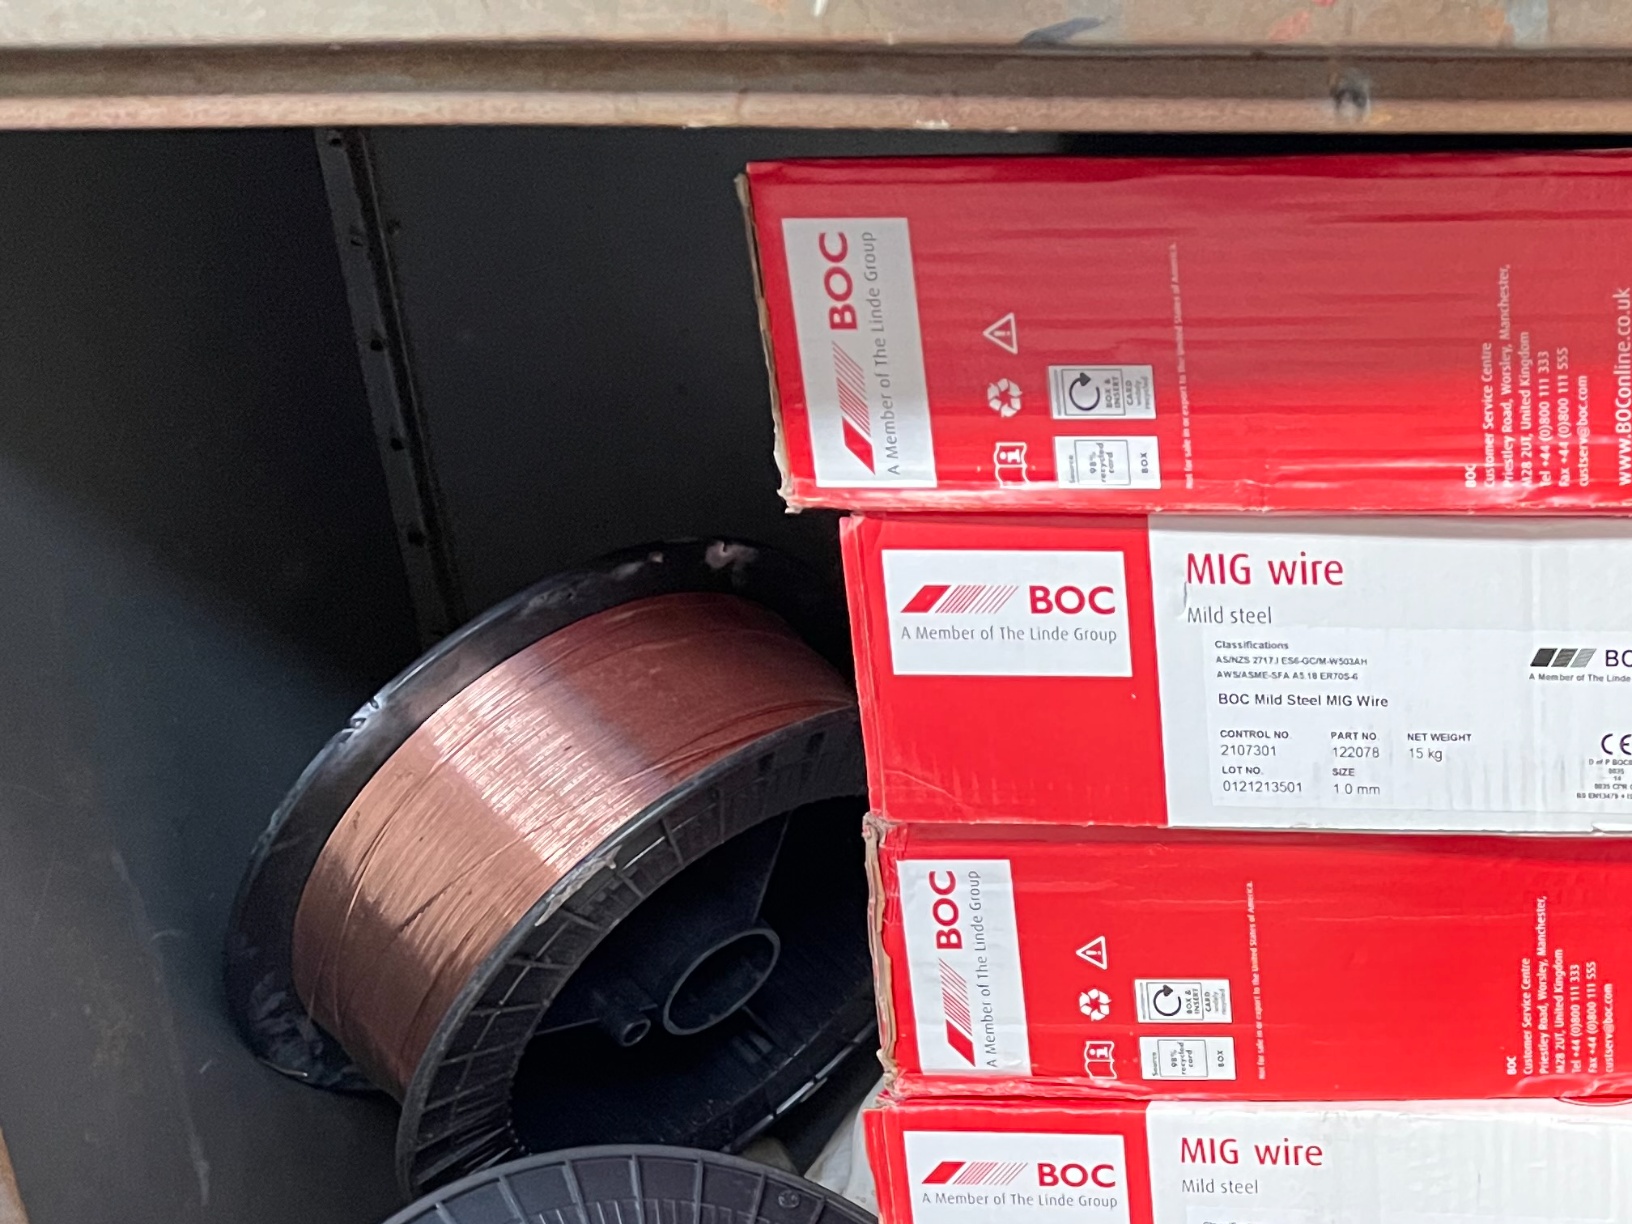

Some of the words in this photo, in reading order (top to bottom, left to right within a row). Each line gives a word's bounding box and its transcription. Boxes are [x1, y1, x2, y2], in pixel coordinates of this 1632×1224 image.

[862, 232, 878, 282] Group
[818, 232, 857, 330] BOC
[868, 288, 884, 332] Linde
[1498, 264, 1510, 340] Manchester,
[873, 338, 887, 366] The
[1481, 343, 1493, 382] Centre
[1517, 331, 1533, 386] Kingdom
[1537, 351, 1550, 373] 333
[1556, 347, 1568, 370] 555
[875, 373, 890, 388] of
[1499, 344, 1513, 395] Worsley,
[1539, 378, 1549, 397] 111
[1557, 375, 1569, 393] 111
[1612, 288, 1632, 486] www.BOConline.co.uk
[1483, 385, 1494, 429] Service
[1500, 399, 1513, 433] Road,
[1519, 390, 1532, 430] United
[1557, 397, 1571, 439] (0)800
[880, 394, 898, 459] Member
[1538, 401, 1553, 442] (0)800
[1576, 375, 1590, 487] custserv@boc.com
[1520, 434, 1533, 458] 2UT,
[1540, 445, 1551, 467] +44
[1558, 441, 1569, 464] +44
[887, 465, 900, 475] A
[1140, 453, 1149, 474] BOX
[1482, 433, 1496, 489] Customer
[1501, 435, 1517, 488] Priestley
[1464, 463, 1478, 488] BOC
[1520, 461, 1536, 489] M28
[1538, 471, 1552, 487] Tel
[1558, 468, 1570, 487] Fax
[1187, 553, 1251, 585] MIG
[1268, 551, 1343, 586] wire
[1029, 586, 1116, 615] BOC
[1188, 606, 1223, 624] Mild
[1230, 606, 1272, 624] steel
[901, 626, 911, 639] A
[916, 625, 975, 640] Member
[980, 625, 993, 640] of
[1000, 626, 1025, 640] The
[1030, 626, 1069, 641] Linde
[1074, 628, 1117, 644] Group
[1215, 640, 1289, 650] Classifications
[1538, 673, 1574, 681] Member
[1588, 674, 1604, 682] The
[1219, 693, 1250, 705] BOC
[1255, 694, 1282, 705] Mild
[1287, 694, 1321, 706] Steel
[1327, 695, 1352, 707] MIG
[1357, 695, 1388, 707] Wire
[1220, 730, 1270, 739] CONTROL
[1331, 732, 1358, 740] PART
[1407, 733, 1427, 741] NET
[1430, 733, 1471, 742] WEIGHT
[1221, 744, 1276, 756] 2107301
[1333, 746, 1380, 758] 122078
[1410, 748, 1423, 759] 15
[1428, 748, 1443, 762] kg
[1222, 766, 1243, 774] LOT
[1332, 768, 1355, 777] SIZE
[1223, 780, 1302, 793] 0121213501
[1357, 786, 1380, 794] mm
[968, 871, 982, 911] Group
[929, 871, 962, 949] BOC
[971, 916, 986, 951] Linde
[1535, 896, 1547, 956] Manchester,
[975, 956, 988, 979] The
[1521, 958, 1531, 990] Centre
[1553, 949, 1566, 993] Kingdom
[1570, 964, 1580, 982] 333
[1586, 961, 1596, 979] 555
[977, 984, 990, 997] of
[1536, 959, 1549, 1000] Worsley,
[1586, 983, 1596, 998] 111
[1570, 986, 1580, 1001] 111
[1522, 992, 1532, 1028] Service
[1537, 1003, 1549, 1030] Road,
[1553, 995, 1565, 1028] United
[1570, 1004, 1582, 1037] (0)800
[1586, 1001, 1598, 1034] (0)800
[980, 1002, 996, 1054] Member
[1603, 983, 1614, 1073] custserv@boc.com
[1554, 1030, 1566, 1050] 2UT,
[1571, 1039, 1580, 1057] +44
[1588, 1037, 1597, 1054] +44
[1217, 1050, 1225, 1067] BOX
[1523, 1030, 1533, 1075] Customer
[1538, 1032, 1550, 1074] Priestley
[1555, 1053, 1565, 1073] M28
[1506, 1056, 1517, 1075] BOC
[1571, 1060, 1581, 1073] Tel
[1588, 1057, 1597, 1073] Fax
[1181, 1138, 1239, 1165] MIG
[1254, 1138, 1323, 1166] wire
[1038, 1163, 1116, 1188] BOC
[1182, 1178, 1214, 1193] Mild
[1221, 1179, 1258, 1194] steel
[923, 1193, 931, 1203] A
[936, 1193, 988, 1205] Member
[993, 1193, 1005, 1205] of
[1010, 1193, 1033, 1206] The
[1038, 1194, 1074, 1206] Linde
[1078, 1195, 1118, 1210] Group
